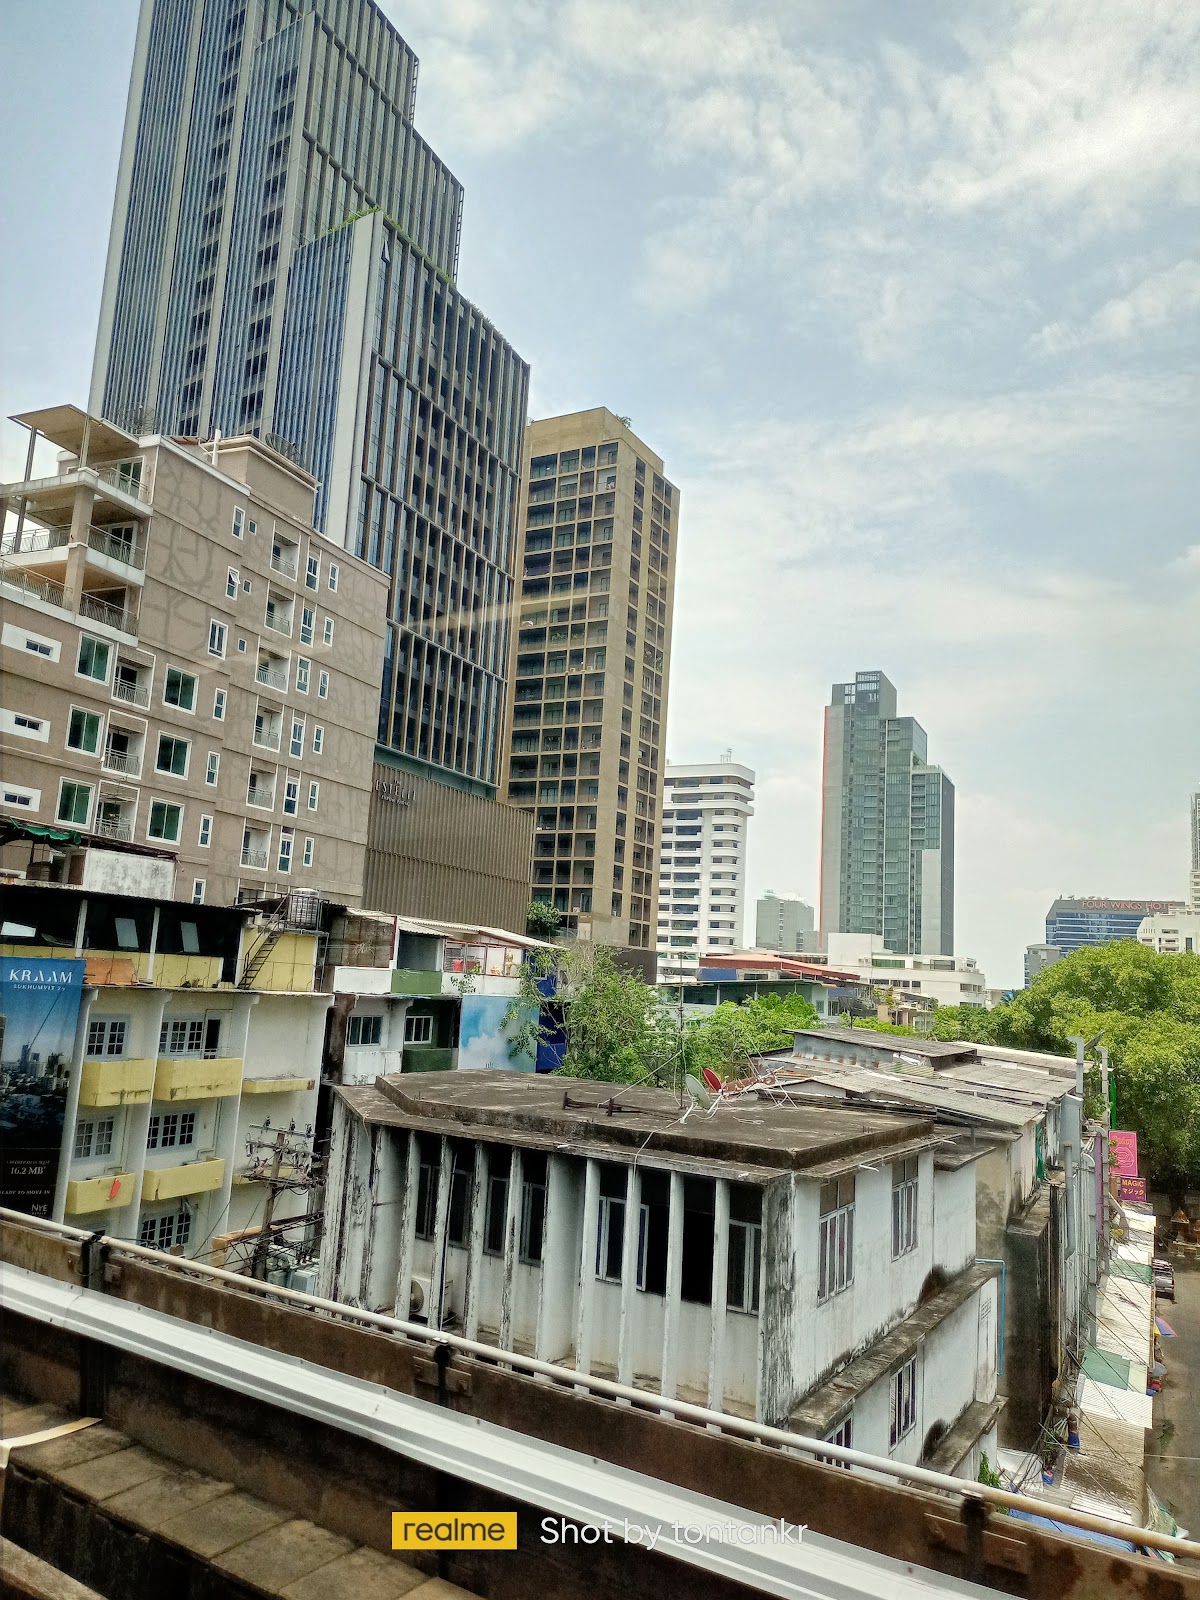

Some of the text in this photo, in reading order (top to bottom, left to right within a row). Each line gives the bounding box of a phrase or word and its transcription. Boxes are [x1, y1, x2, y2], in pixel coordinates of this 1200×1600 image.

[1082, 900, 1176, 910] FOUR WINGS HOT
[9, 969, 72, 983] KRAAM
[13, 983, 55, 991] SUKHUMVIT
[10, 1166, 27, 1175] 16.2
[1121, 1179, 1144, 1188] MAGIC
